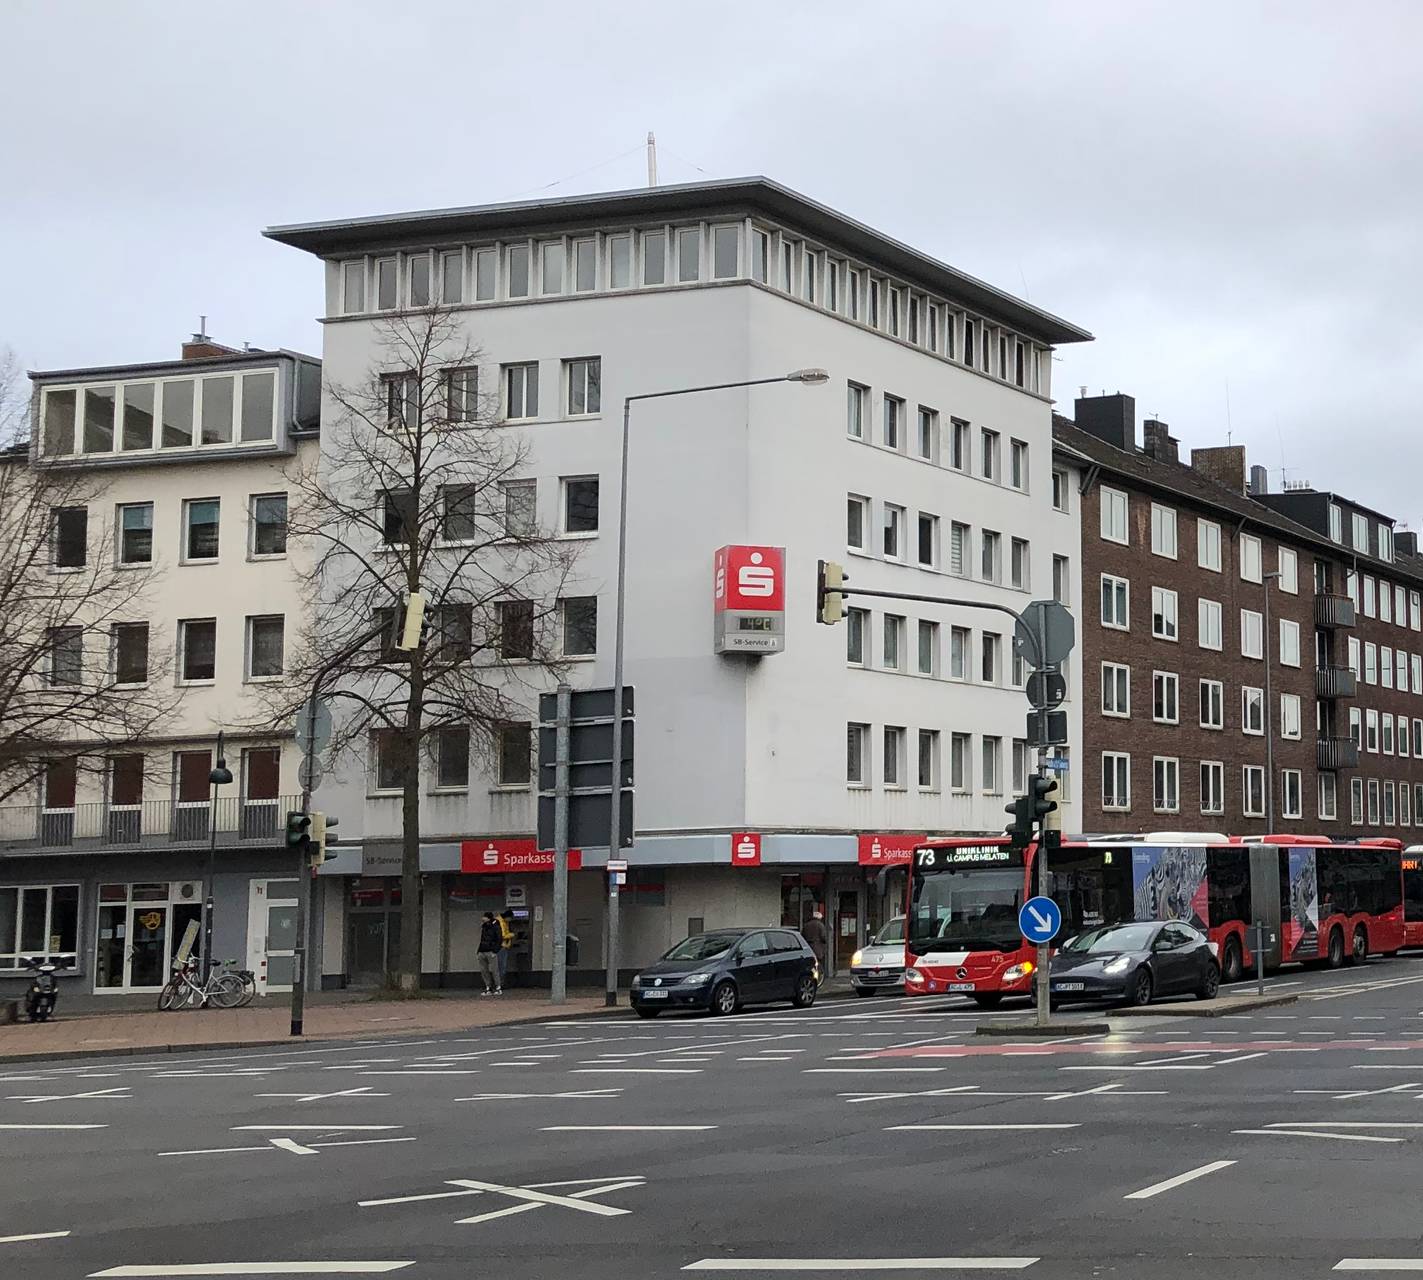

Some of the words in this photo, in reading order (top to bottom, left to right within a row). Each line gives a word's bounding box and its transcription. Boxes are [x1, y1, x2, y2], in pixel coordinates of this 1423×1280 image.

[733, 638, 769, 647] SB-Service
[883, 846, 912, 861] Sparkass
[956, 845, 1000, 855] UNIKLINIK
[916, 848, 936, 866] 73
[953, 854, 980, 863] CAMPUS
[980, 852, 1010, 862] MELATEN
